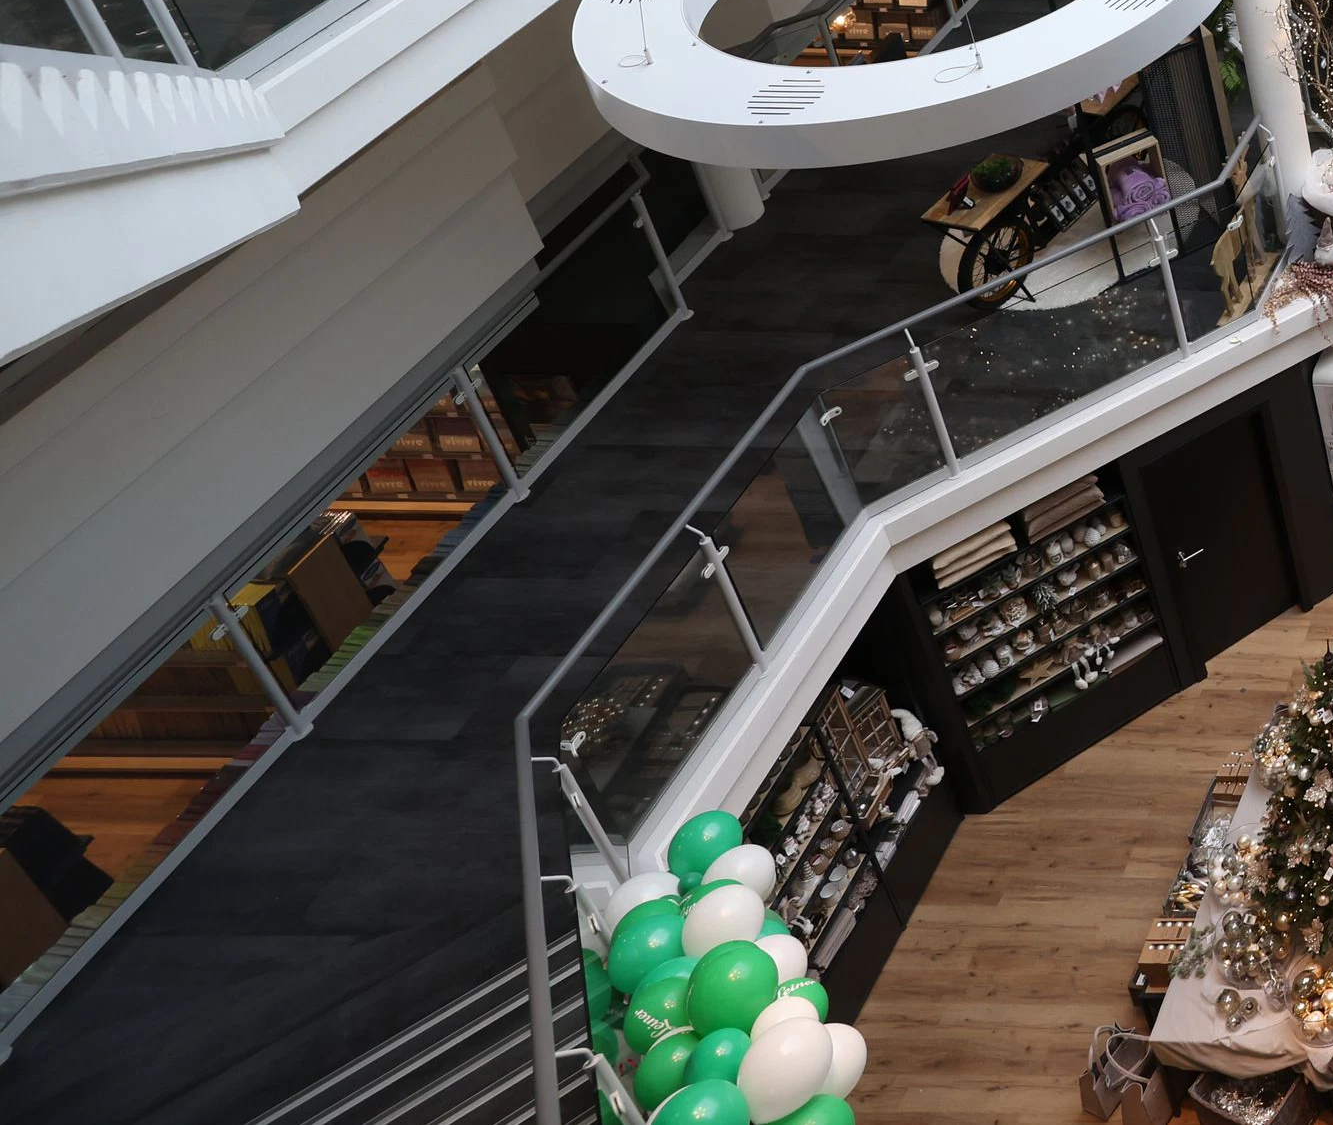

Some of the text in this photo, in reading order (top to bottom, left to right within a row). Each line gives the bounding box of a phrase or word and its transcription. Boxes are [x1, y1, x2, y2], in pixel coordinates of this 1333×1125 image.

[445, 436, 473, 446] vivre
[467, 478, 496, 488] vivre
[776, 979, 816, 1000] Leiner
[634, 1008, 673, 1038] Leiner
